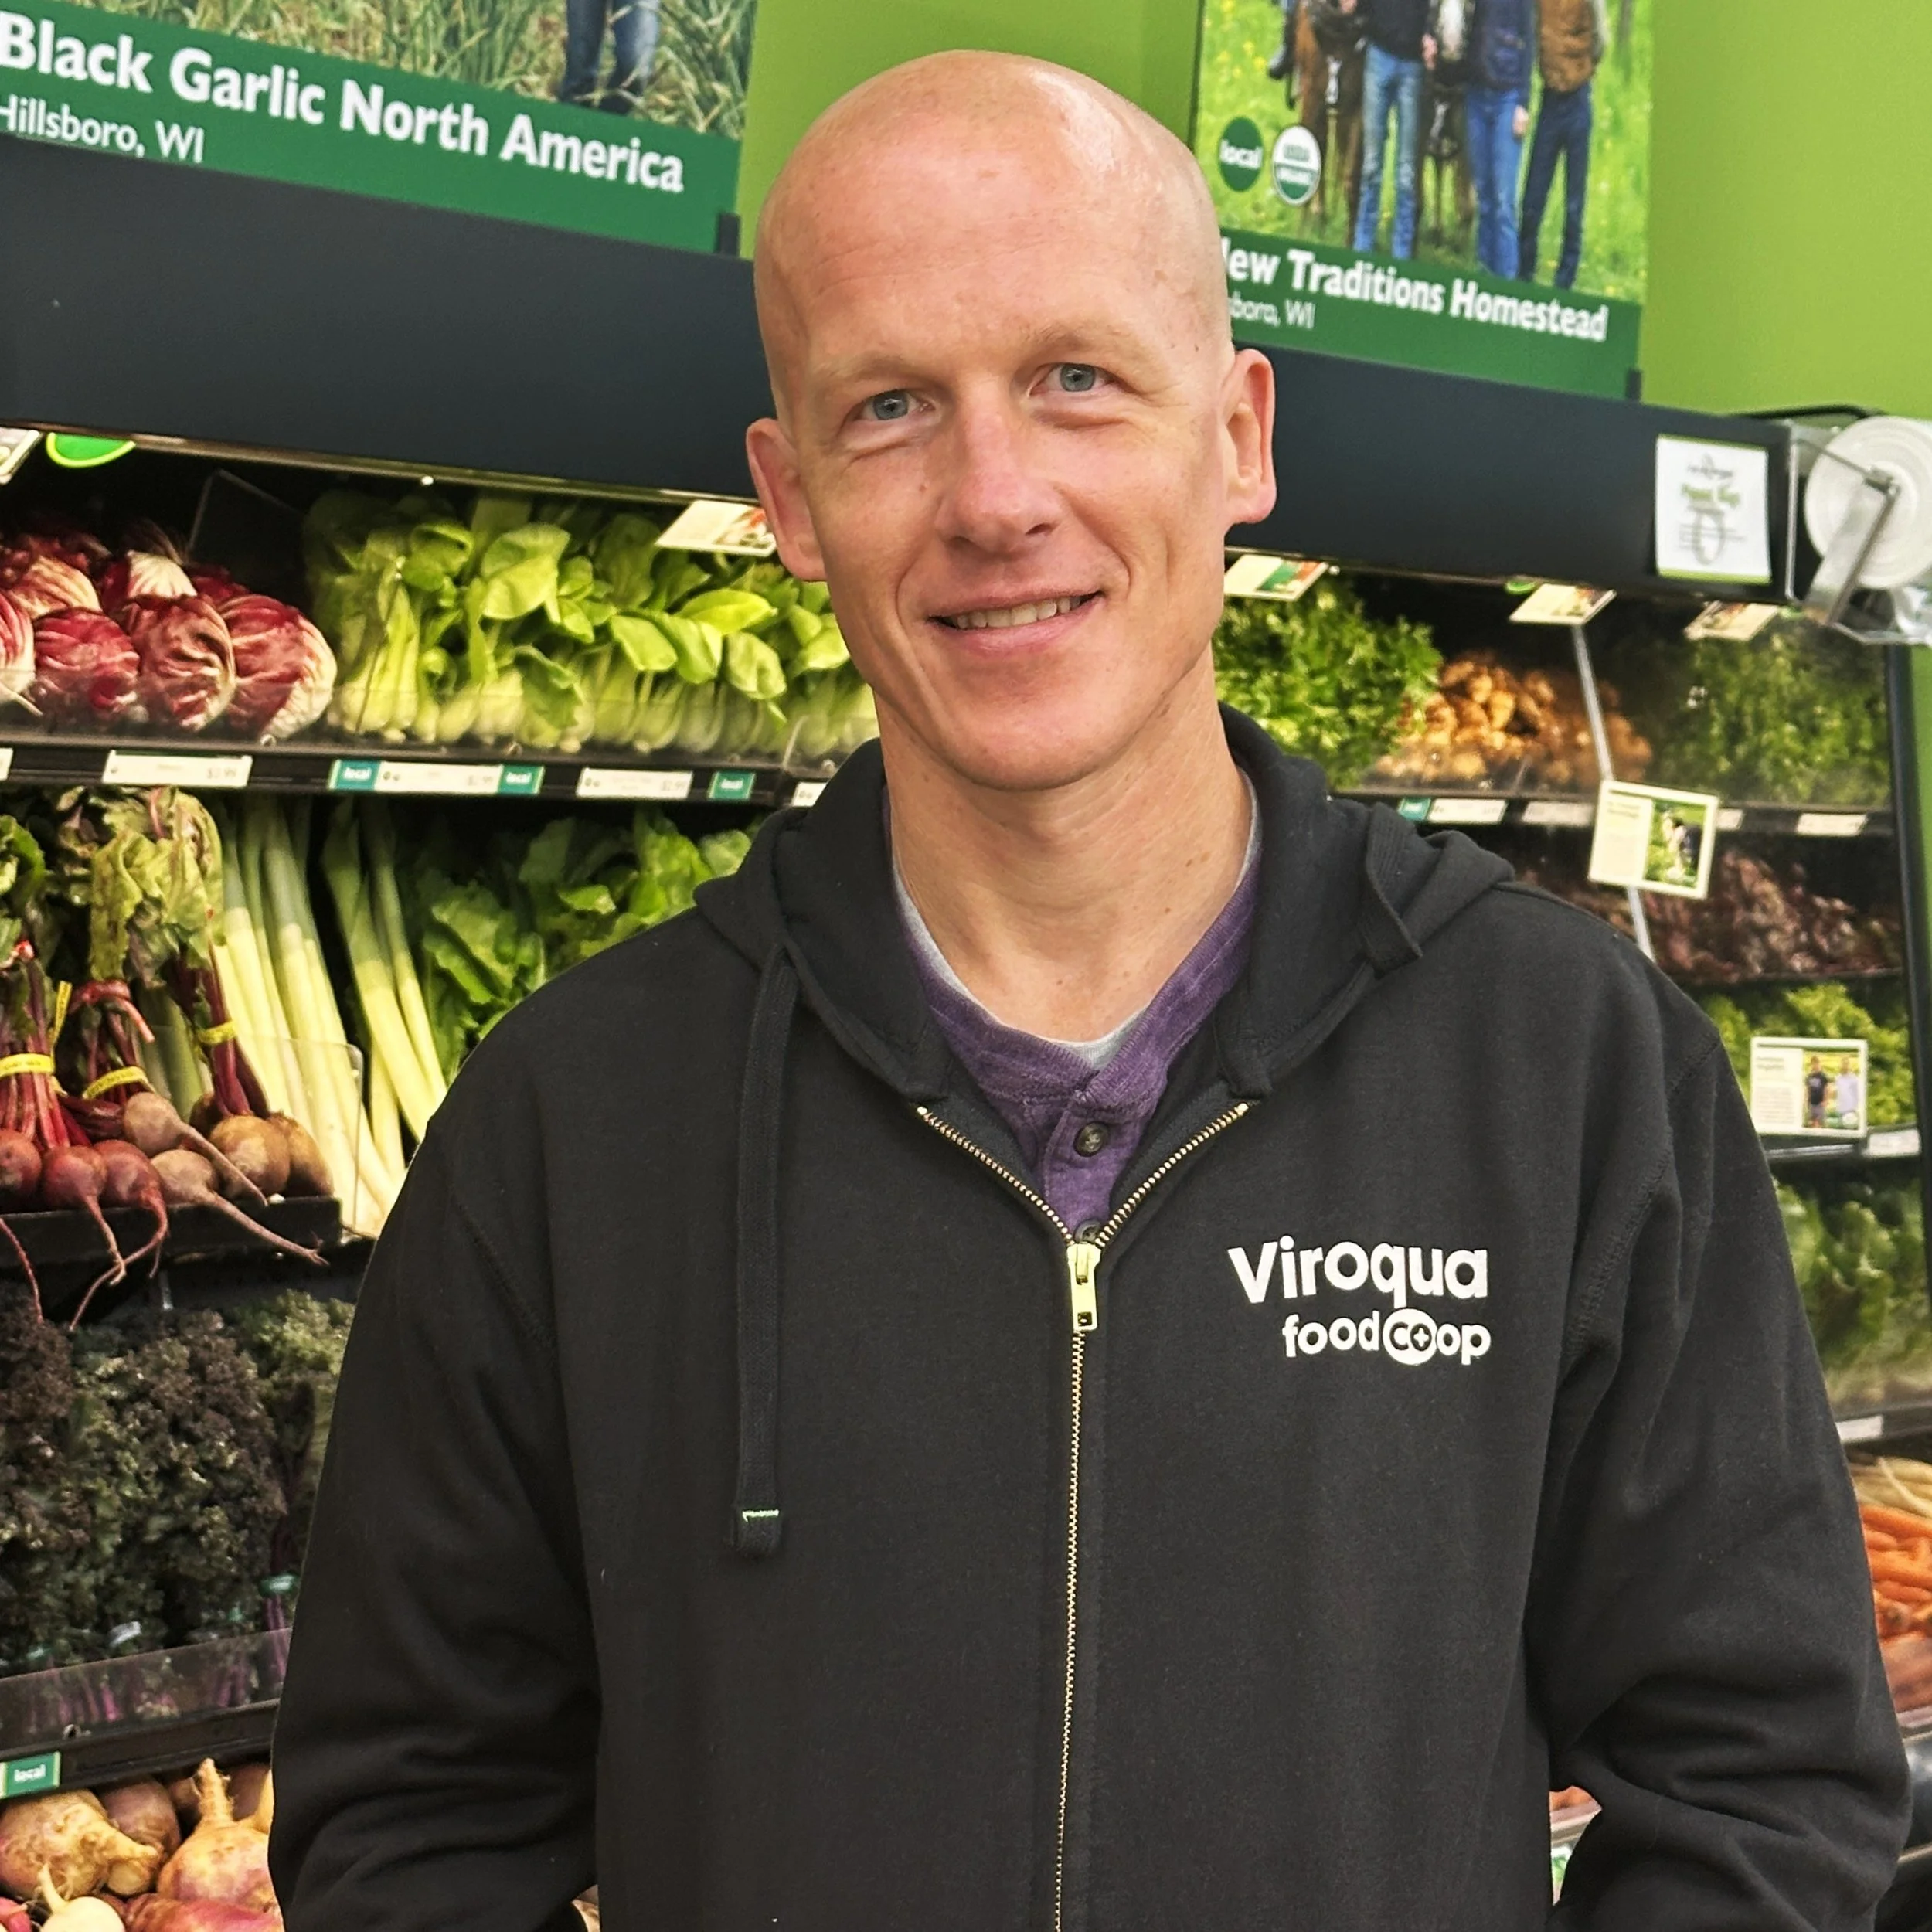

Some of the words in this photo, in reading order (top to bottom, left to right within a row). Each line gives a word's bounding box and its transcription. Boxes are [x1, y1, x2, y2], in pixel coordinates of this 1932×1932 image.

[0, 10, 154, 94] Black
[169, 46, 326, 125] Garlic
[339, 78, 489, 156] North
[499, 113, 684, 193] America
[0, 94, 145, 158] Hillsboro,
[155, 119, 205, 164] WI
[1219, 138, 1263, 169] local
[1284, 298, 1316, 329] WI
[1287, 248, 1445, 315] Traditions
[1449, 277, 1609, 342] Homestead
[1227, 1235, 1488, 1309] Viroqua
[14, 1764, 46, 1782] local
